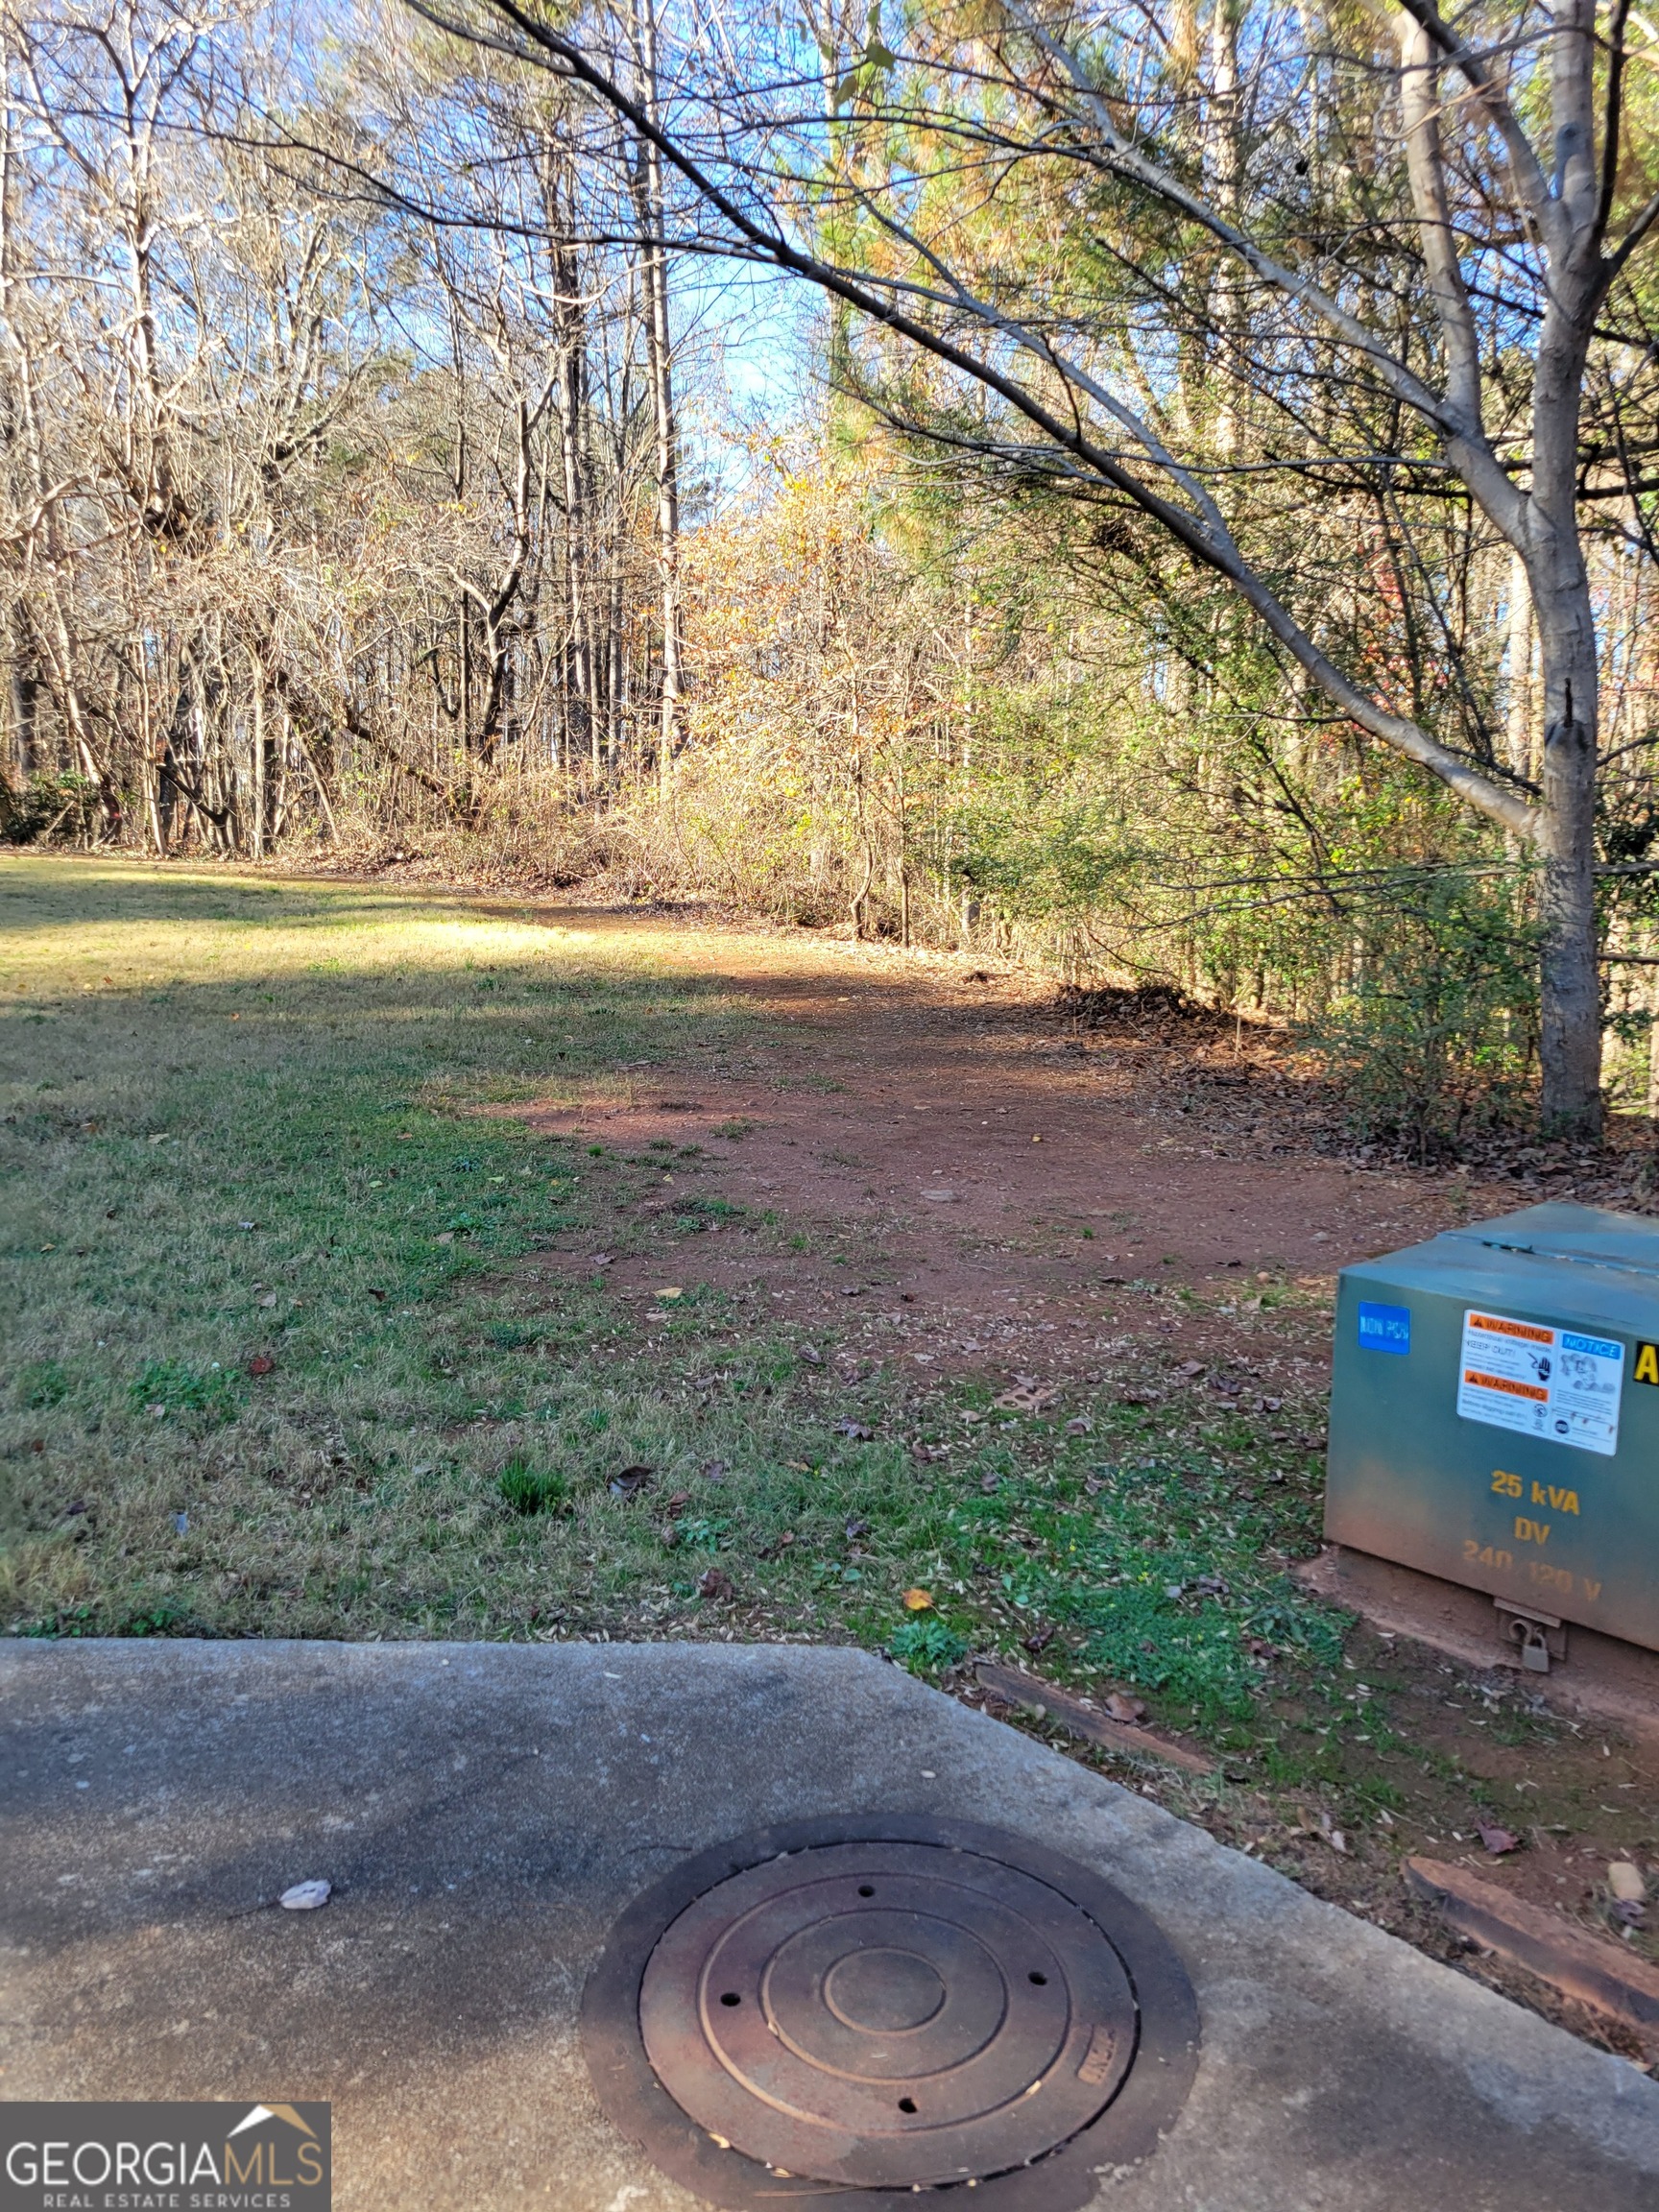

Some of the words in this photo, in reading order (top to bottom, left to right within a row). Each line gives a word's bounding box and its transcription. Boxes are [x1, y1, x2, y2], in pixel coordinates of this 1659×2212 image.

[1486, 1320, 1551, 1343] WARNING
[1466, 1338, 1489, 1351] KEEP
[1565, 1336, 1618, 1358] NOTICE
[1481, 1378, 1545, 1401] WARNING
[1491, 1470, 1523, 1499] 25
[1531, 1480, 1580, 1516] kVA
[1514, 1516, 1551, 1546] DV
